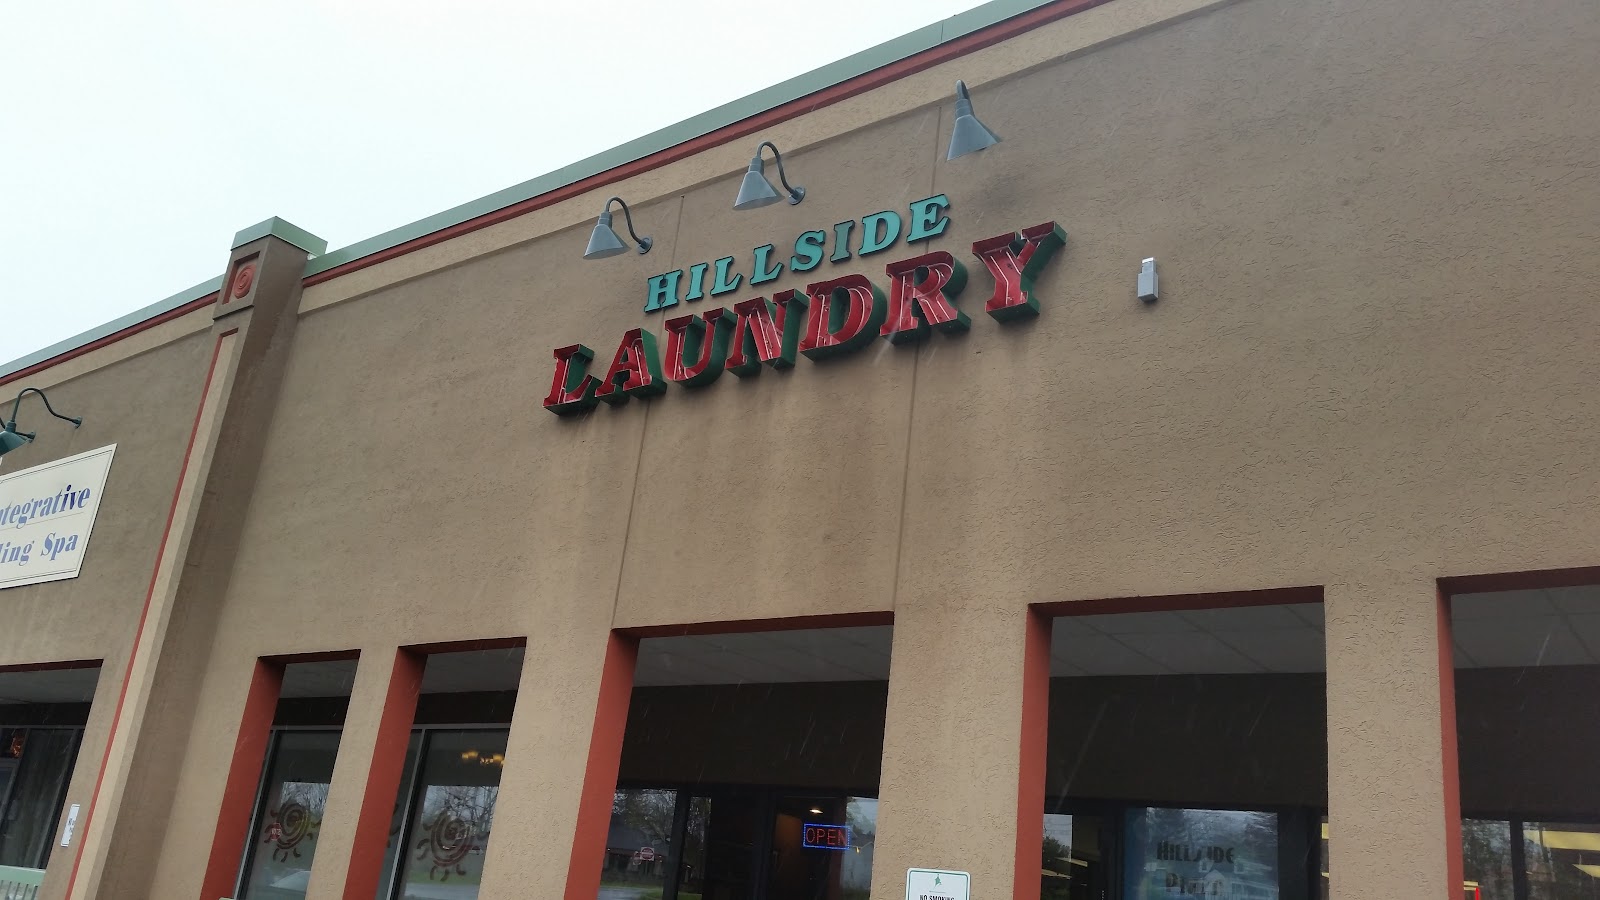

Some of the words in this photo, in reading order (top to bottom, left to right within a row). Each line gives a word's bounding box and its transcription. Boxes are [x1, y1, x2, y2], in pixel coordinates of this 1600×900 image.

[644, 193, 951, 314] HILLSIDE
[543, 221, 1067, 417] LAUNDRY
[40, 532, 78, 561] Spa
[806, 828, 847, 846] OPEN
